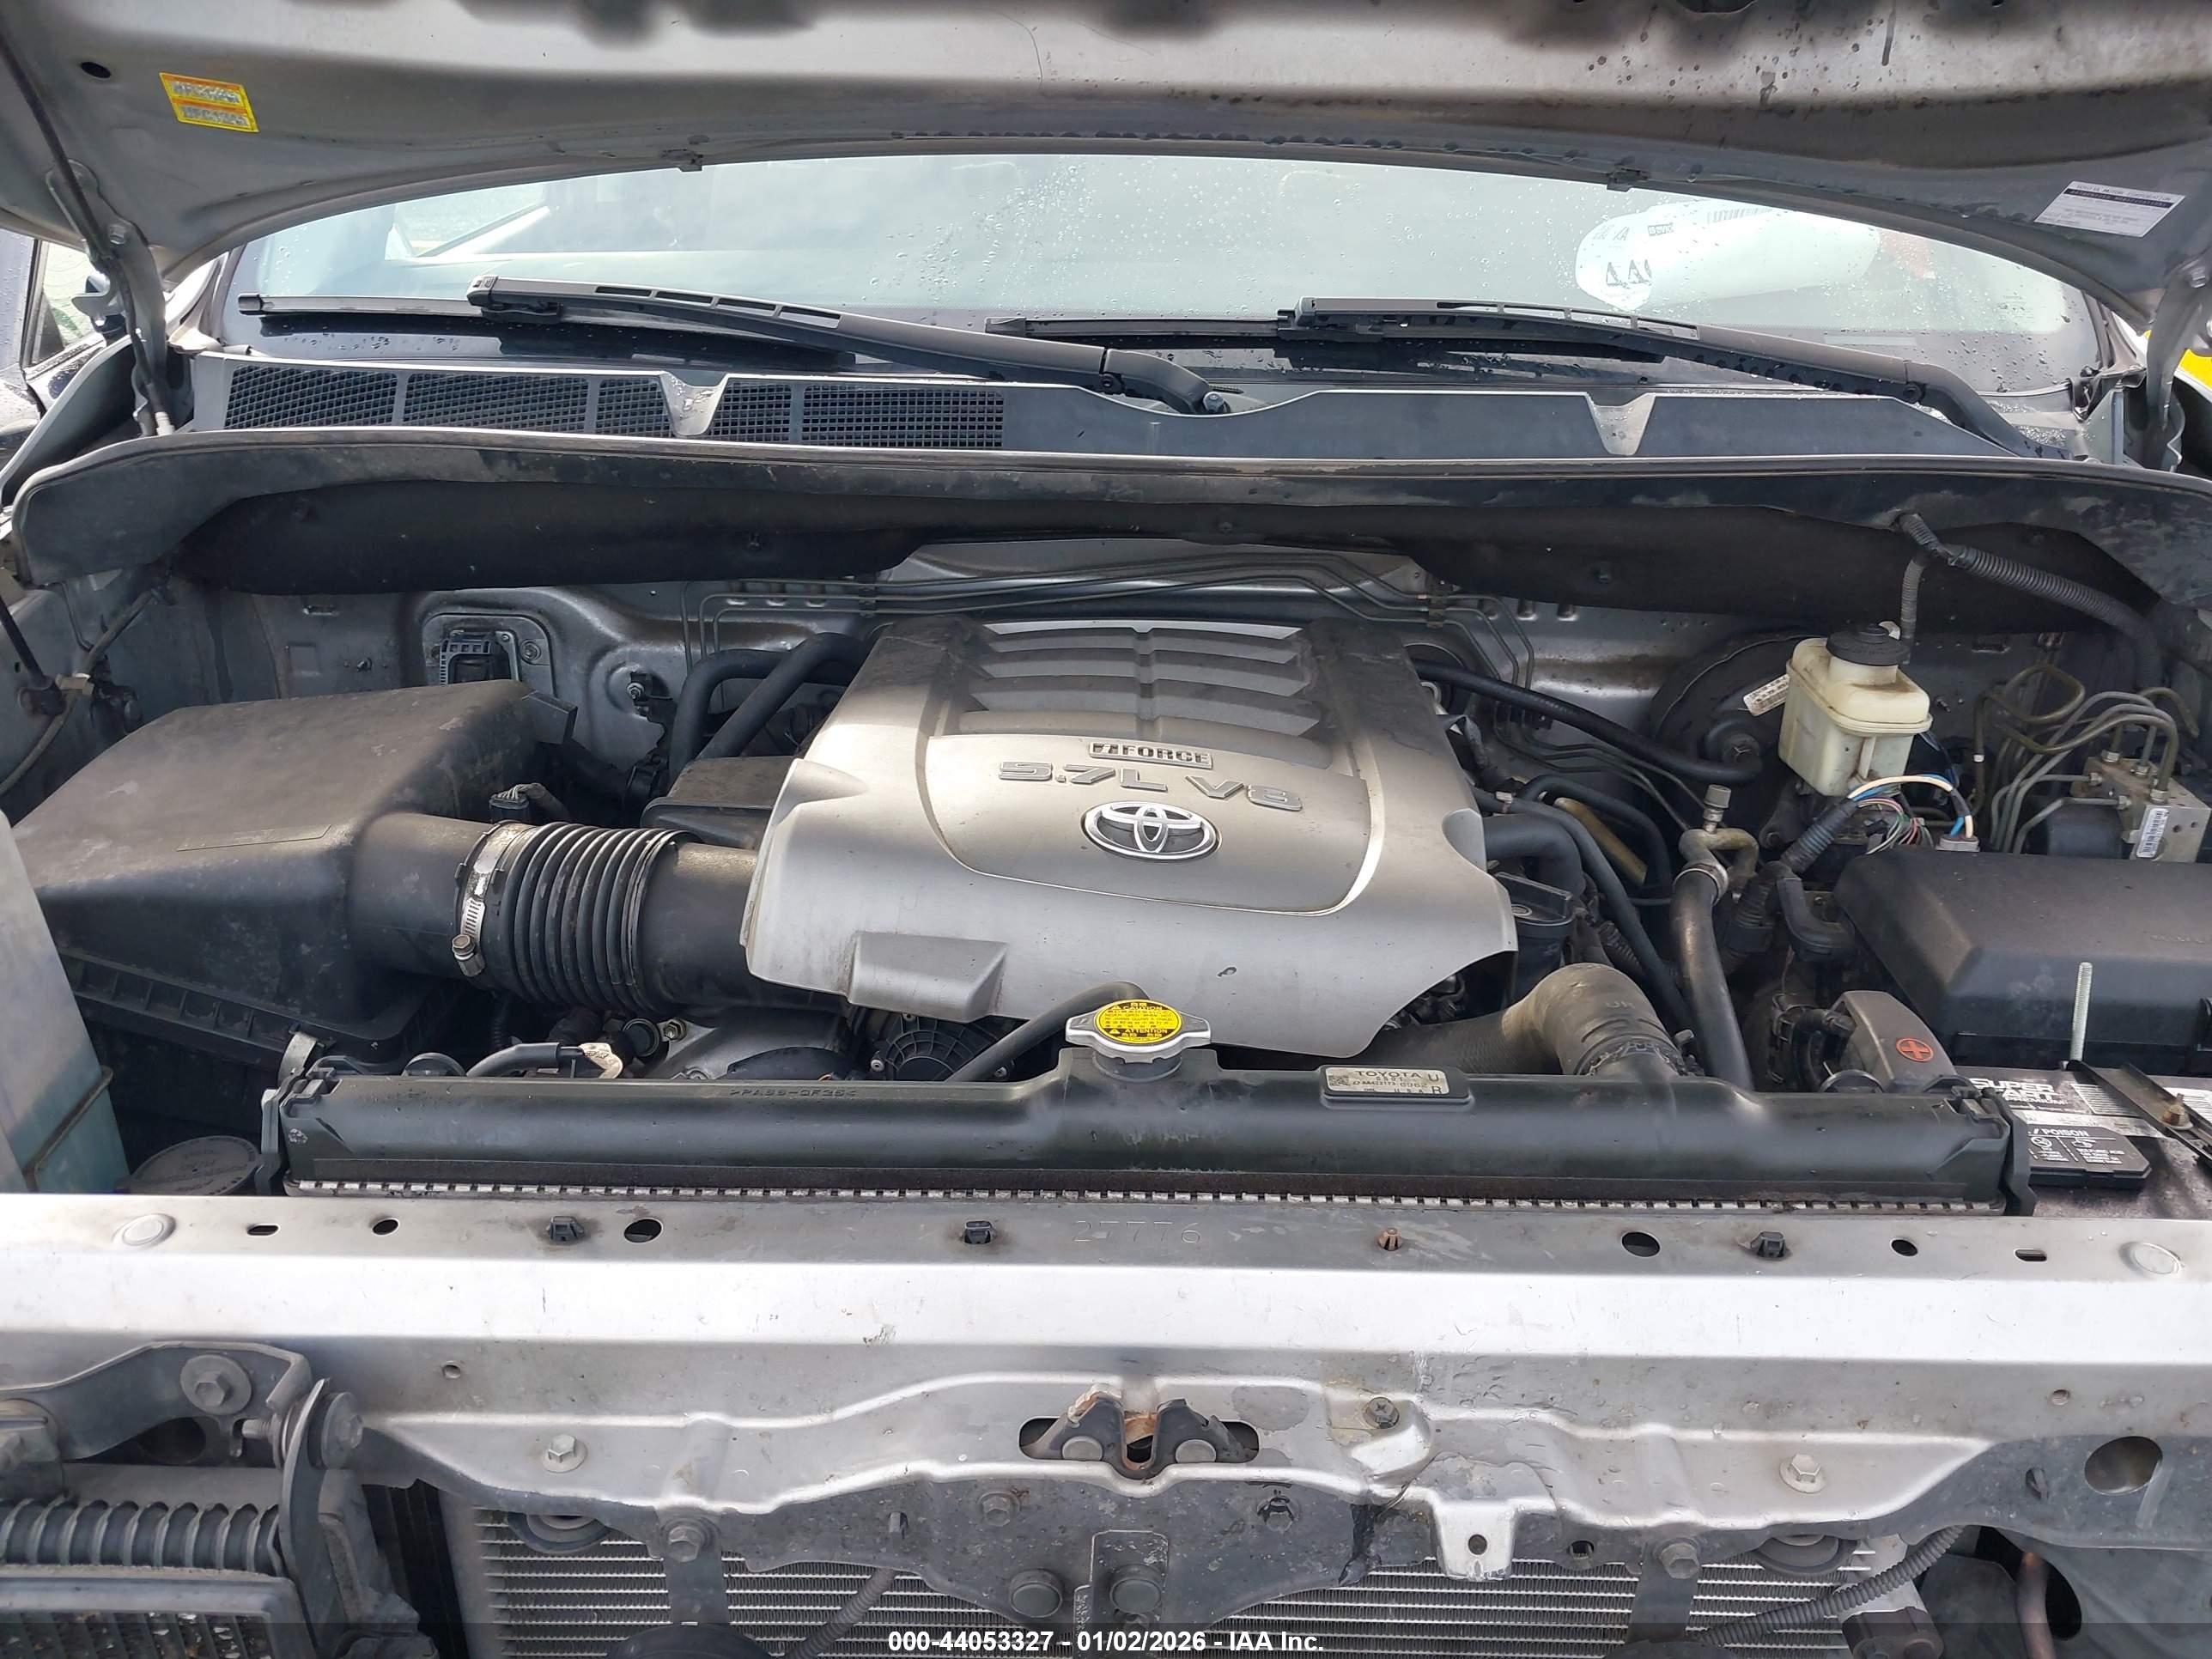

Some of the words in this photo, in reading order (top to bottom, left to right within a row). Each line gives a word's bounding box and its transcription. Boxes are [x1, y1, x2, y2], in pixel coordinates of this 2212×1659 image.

[999, 762, 1168, 793] 5.7L
[1185, 775, 1304, 811] V8
[1355, 1070, 1422, 1079] TOYOTA
[1428, 1073, 1439, 1082] U
[1431, 1085, 1443, 1094] R
[1969, 1078, 2055, 1093] SUPER
[2041, 1128, 2089, 1137] POISON
[1072, 1219, 1202, 1243] 27776
